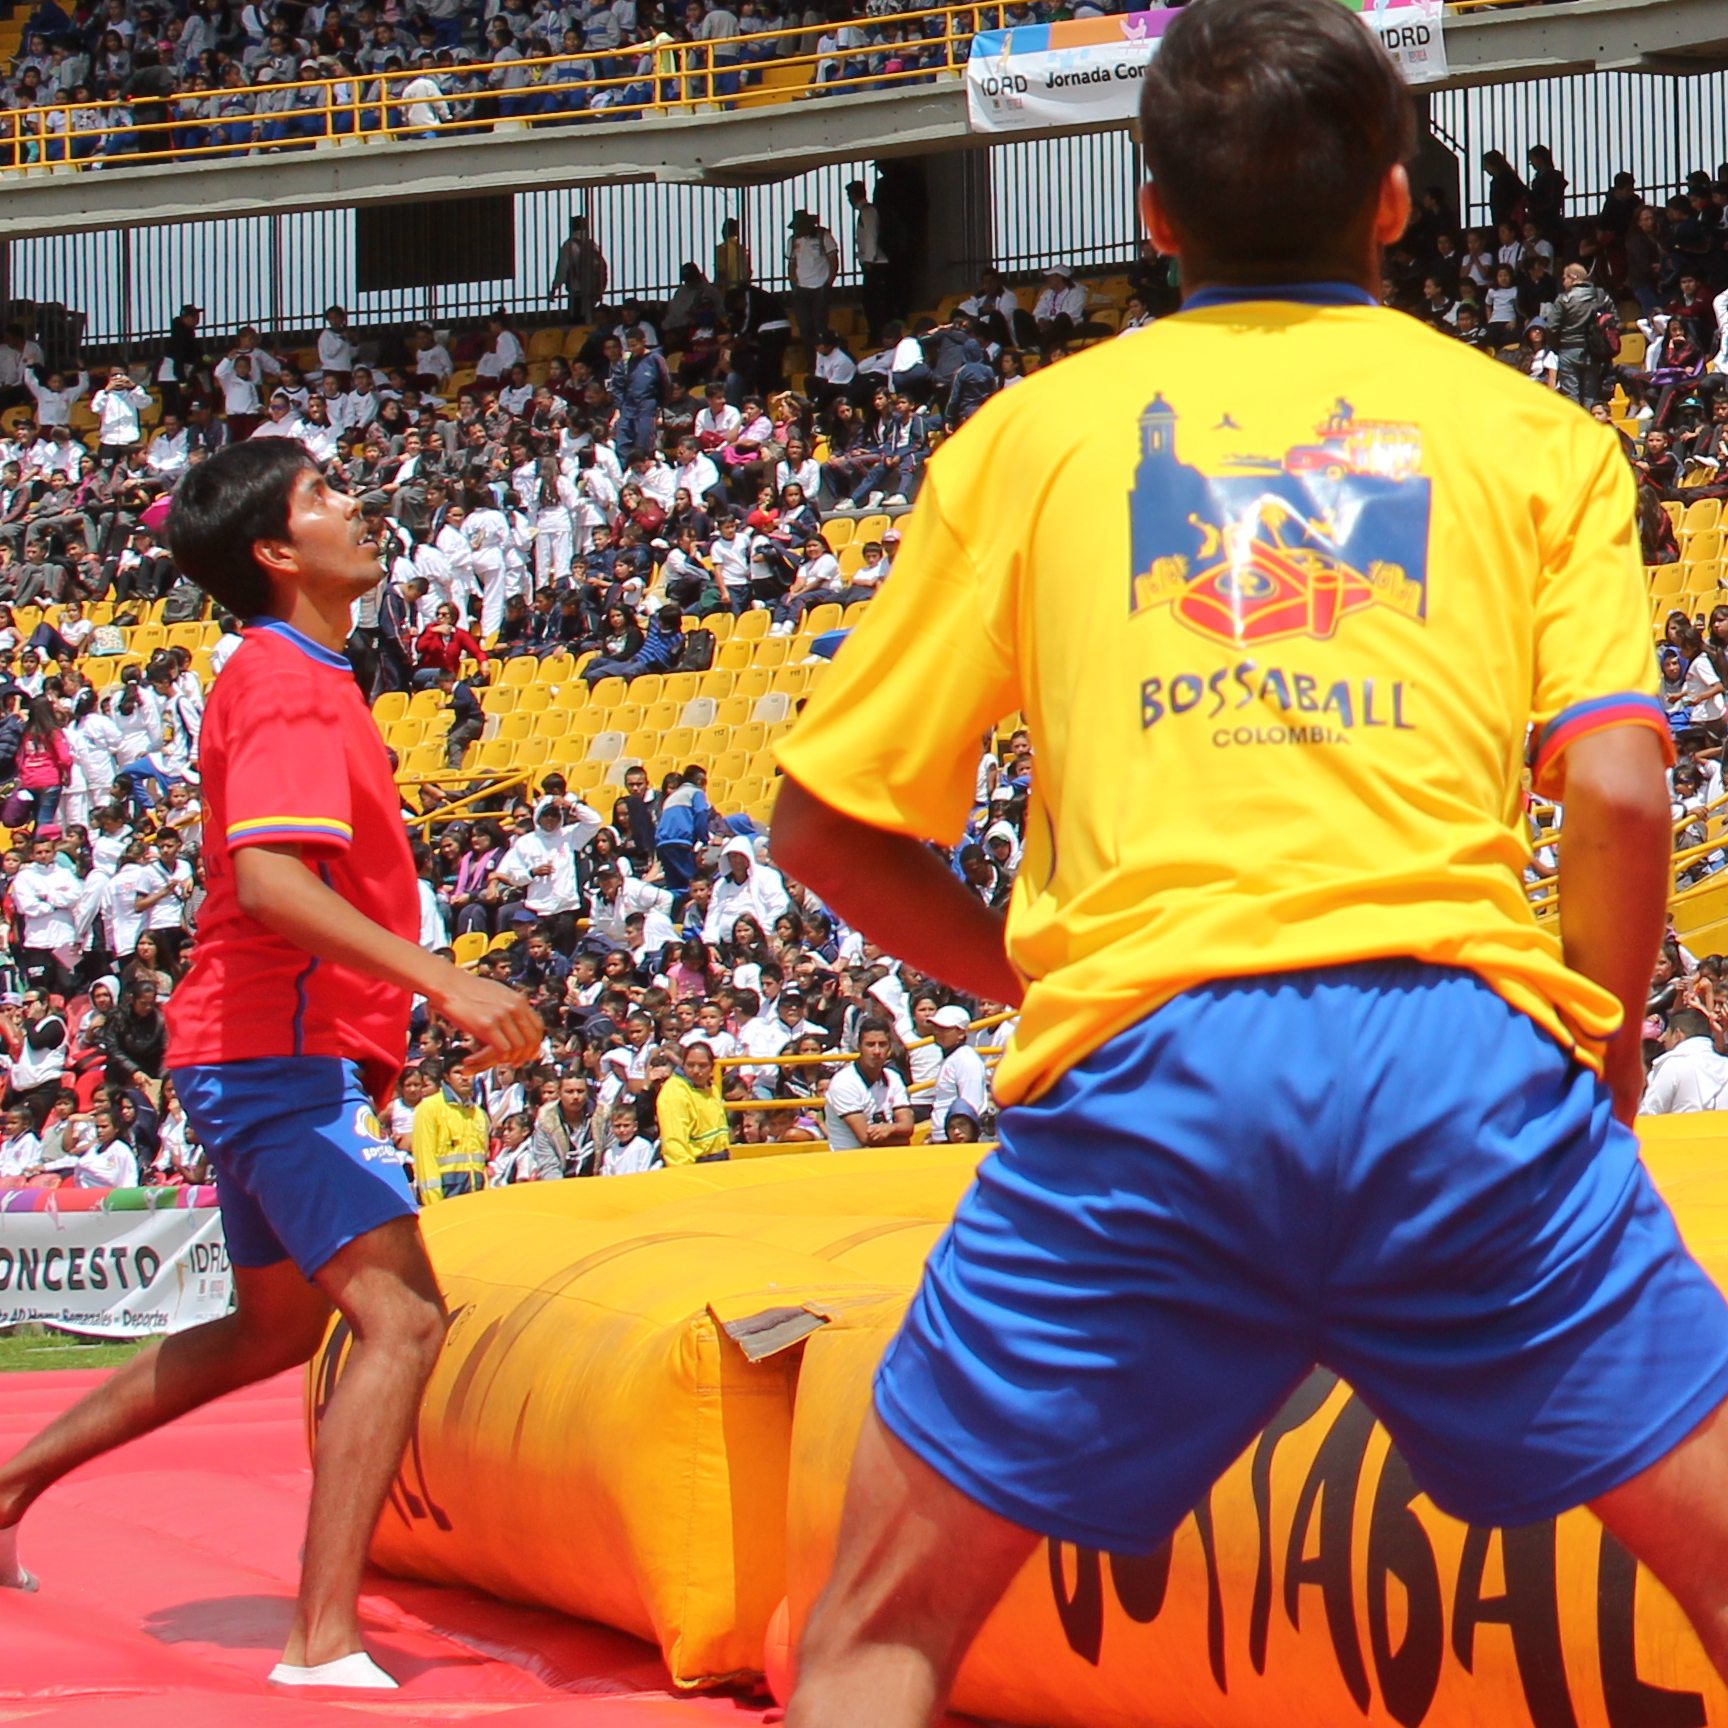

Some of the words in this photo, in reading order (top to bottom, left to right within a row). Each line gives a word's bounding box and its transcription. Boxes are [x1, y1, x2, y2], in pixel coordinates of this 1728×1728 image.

[981, 74, 1027, 97] IDRD
[1046, 67, 1110, 90] Jornada
[1140, 657, 1417, 731] BOSSABALL
[1212, 726, 1349, 748] COLOMBIA
[123, 1308, 168, 1329] Deportes
